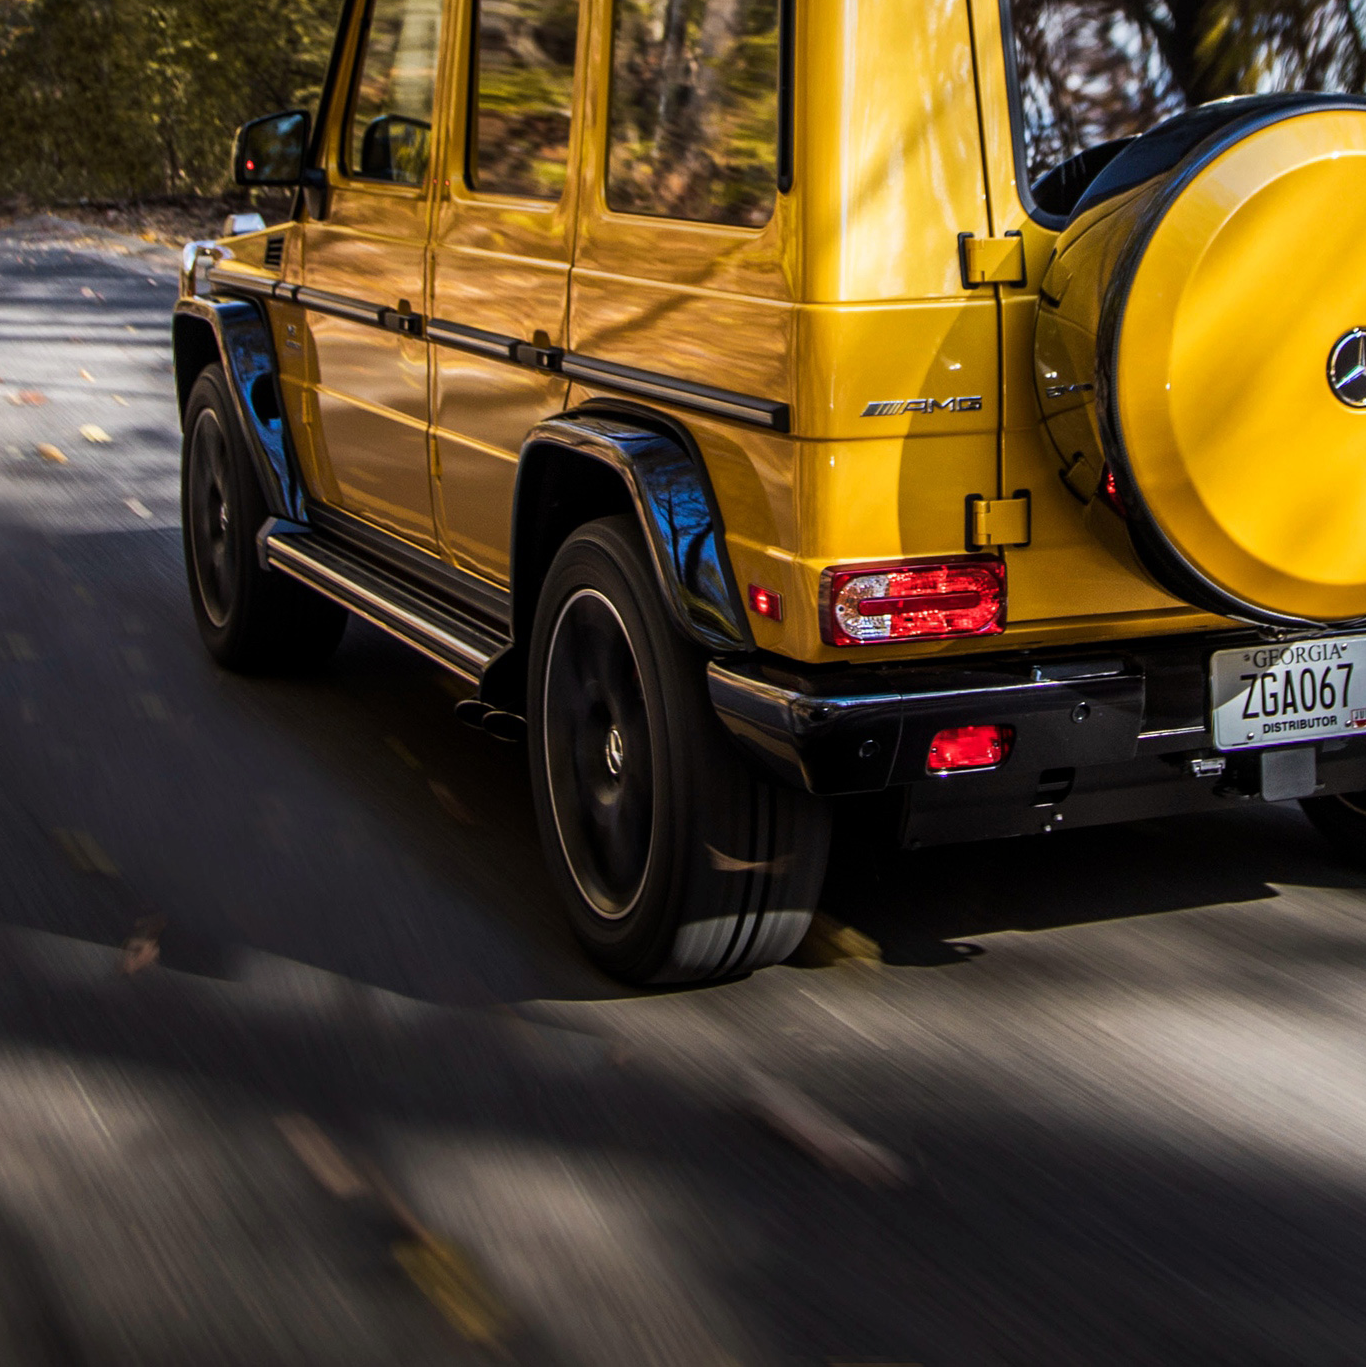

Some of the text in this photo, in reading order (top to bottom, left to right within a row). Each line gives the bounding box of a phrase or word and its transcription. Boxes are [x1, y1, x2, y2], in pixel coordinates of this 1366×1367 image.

[898, 395, 982, 416] AMG
[1253, 643, 1342, 668] GEORGIA
[1240, 663, 1353, 720] ZGA067
[1263, 715, 1337, 734] DISTRIBUTOR
